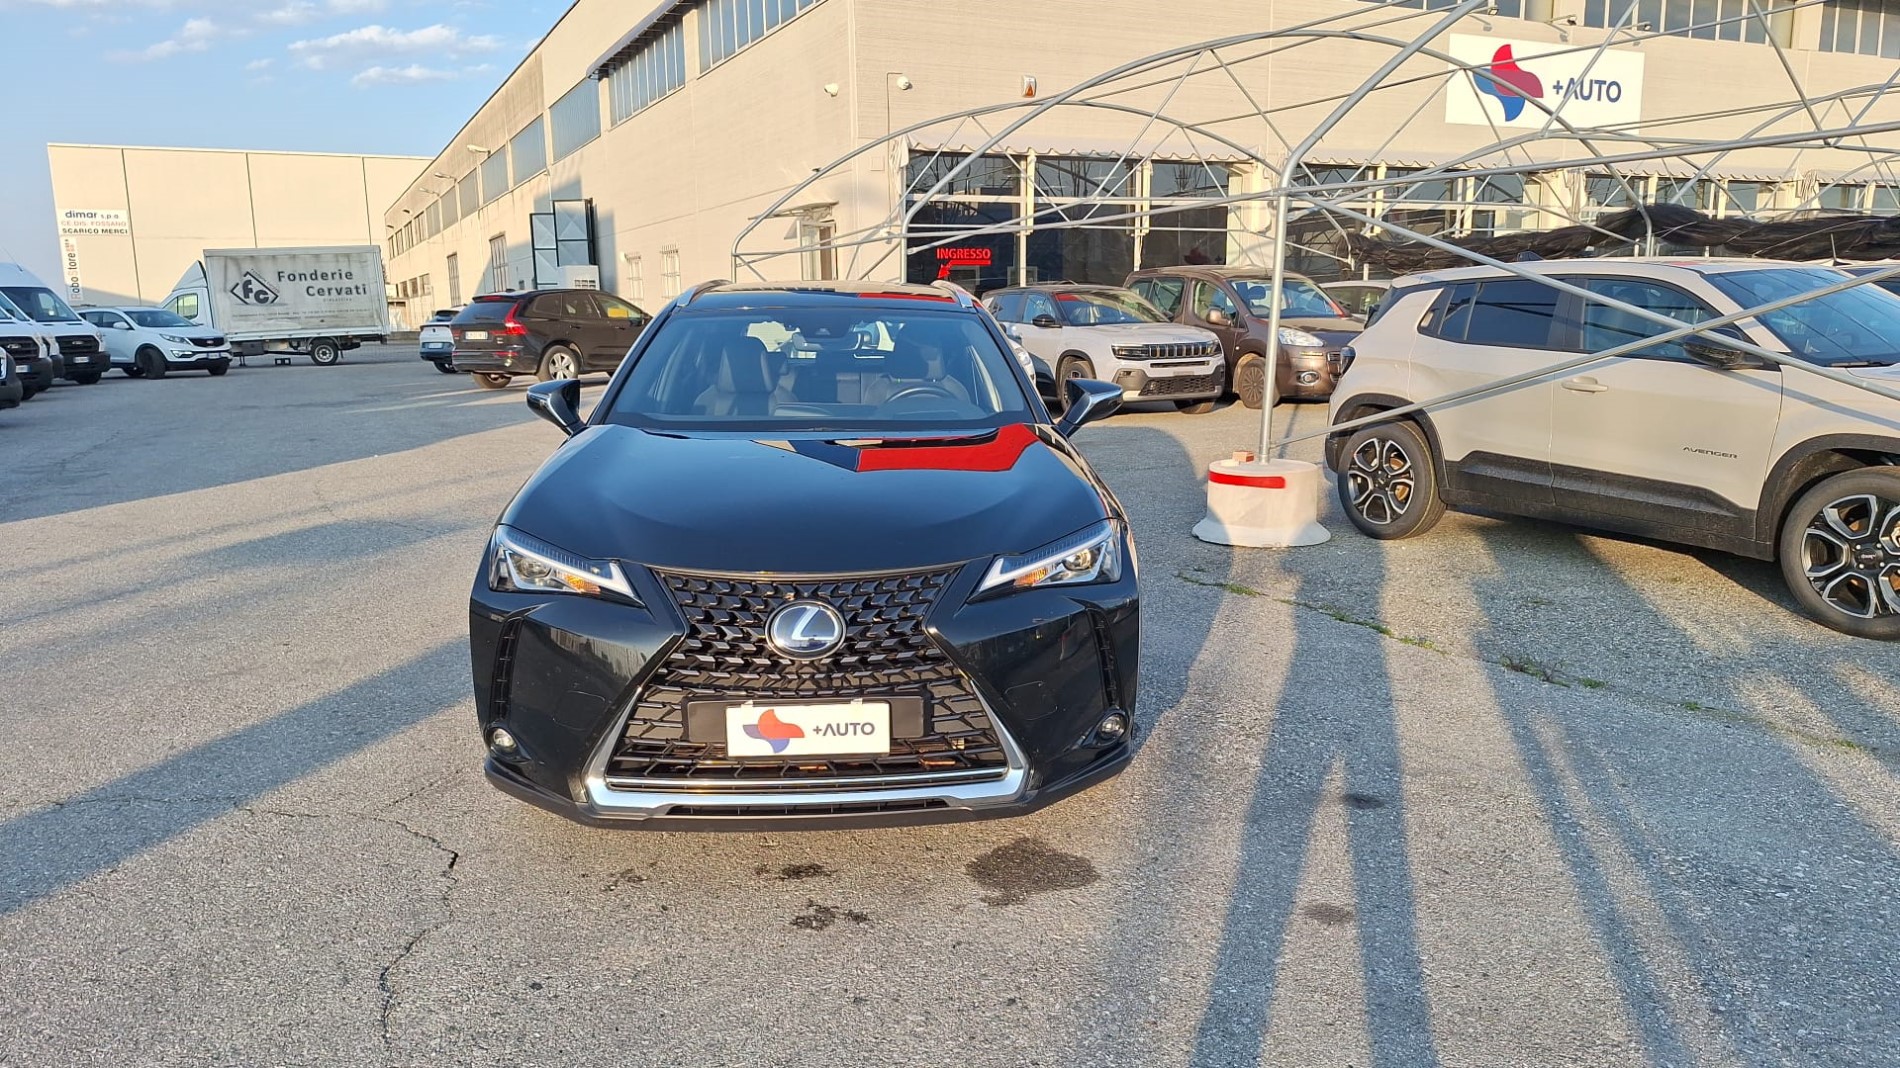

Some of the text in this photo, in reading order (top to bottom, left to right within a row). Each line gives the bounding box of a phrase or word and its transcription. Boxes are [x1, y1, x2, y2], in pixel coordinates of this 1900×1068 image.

[1553, 77, 1622, 103] +AUTO
[65, 210, 97, 219] dimar
[91, 220, 127, 228] FOSSANO
[936, 247, 992, 260] INGRESSO
[277, 268, 354, 282] Fonderie
[306, 284, 368, 297] Cervati
[1682, 446, 1738, 459] AVENGER
[813, 722, 875, 737] +AUTO
